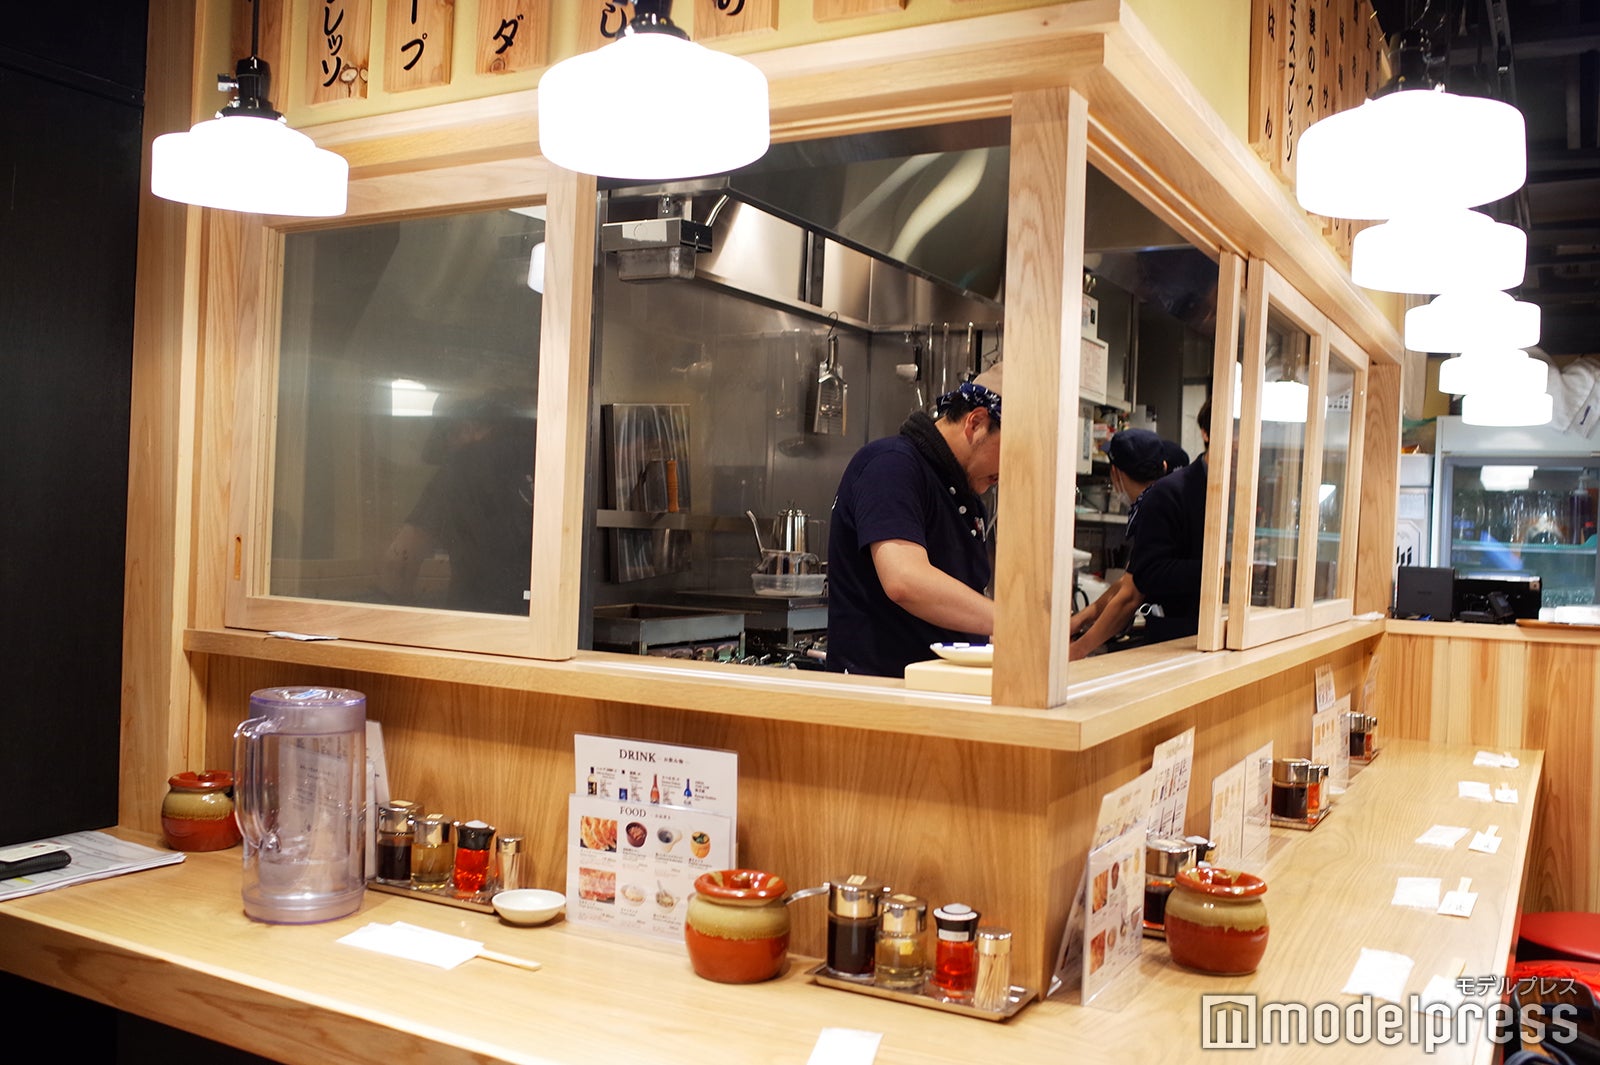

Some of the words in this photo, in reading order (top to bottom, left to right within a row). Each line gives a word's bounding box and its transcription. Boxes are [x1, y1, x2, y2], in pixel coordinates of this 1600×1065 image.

[322, 0, 344, 87] レッソ
[493, 14, 524, 54] ダ
[1286, 0, 1297, 162] エスプレッソ
[619, 749, 656, 763] DRINK
[619, 806, 647, 818] FOOD
